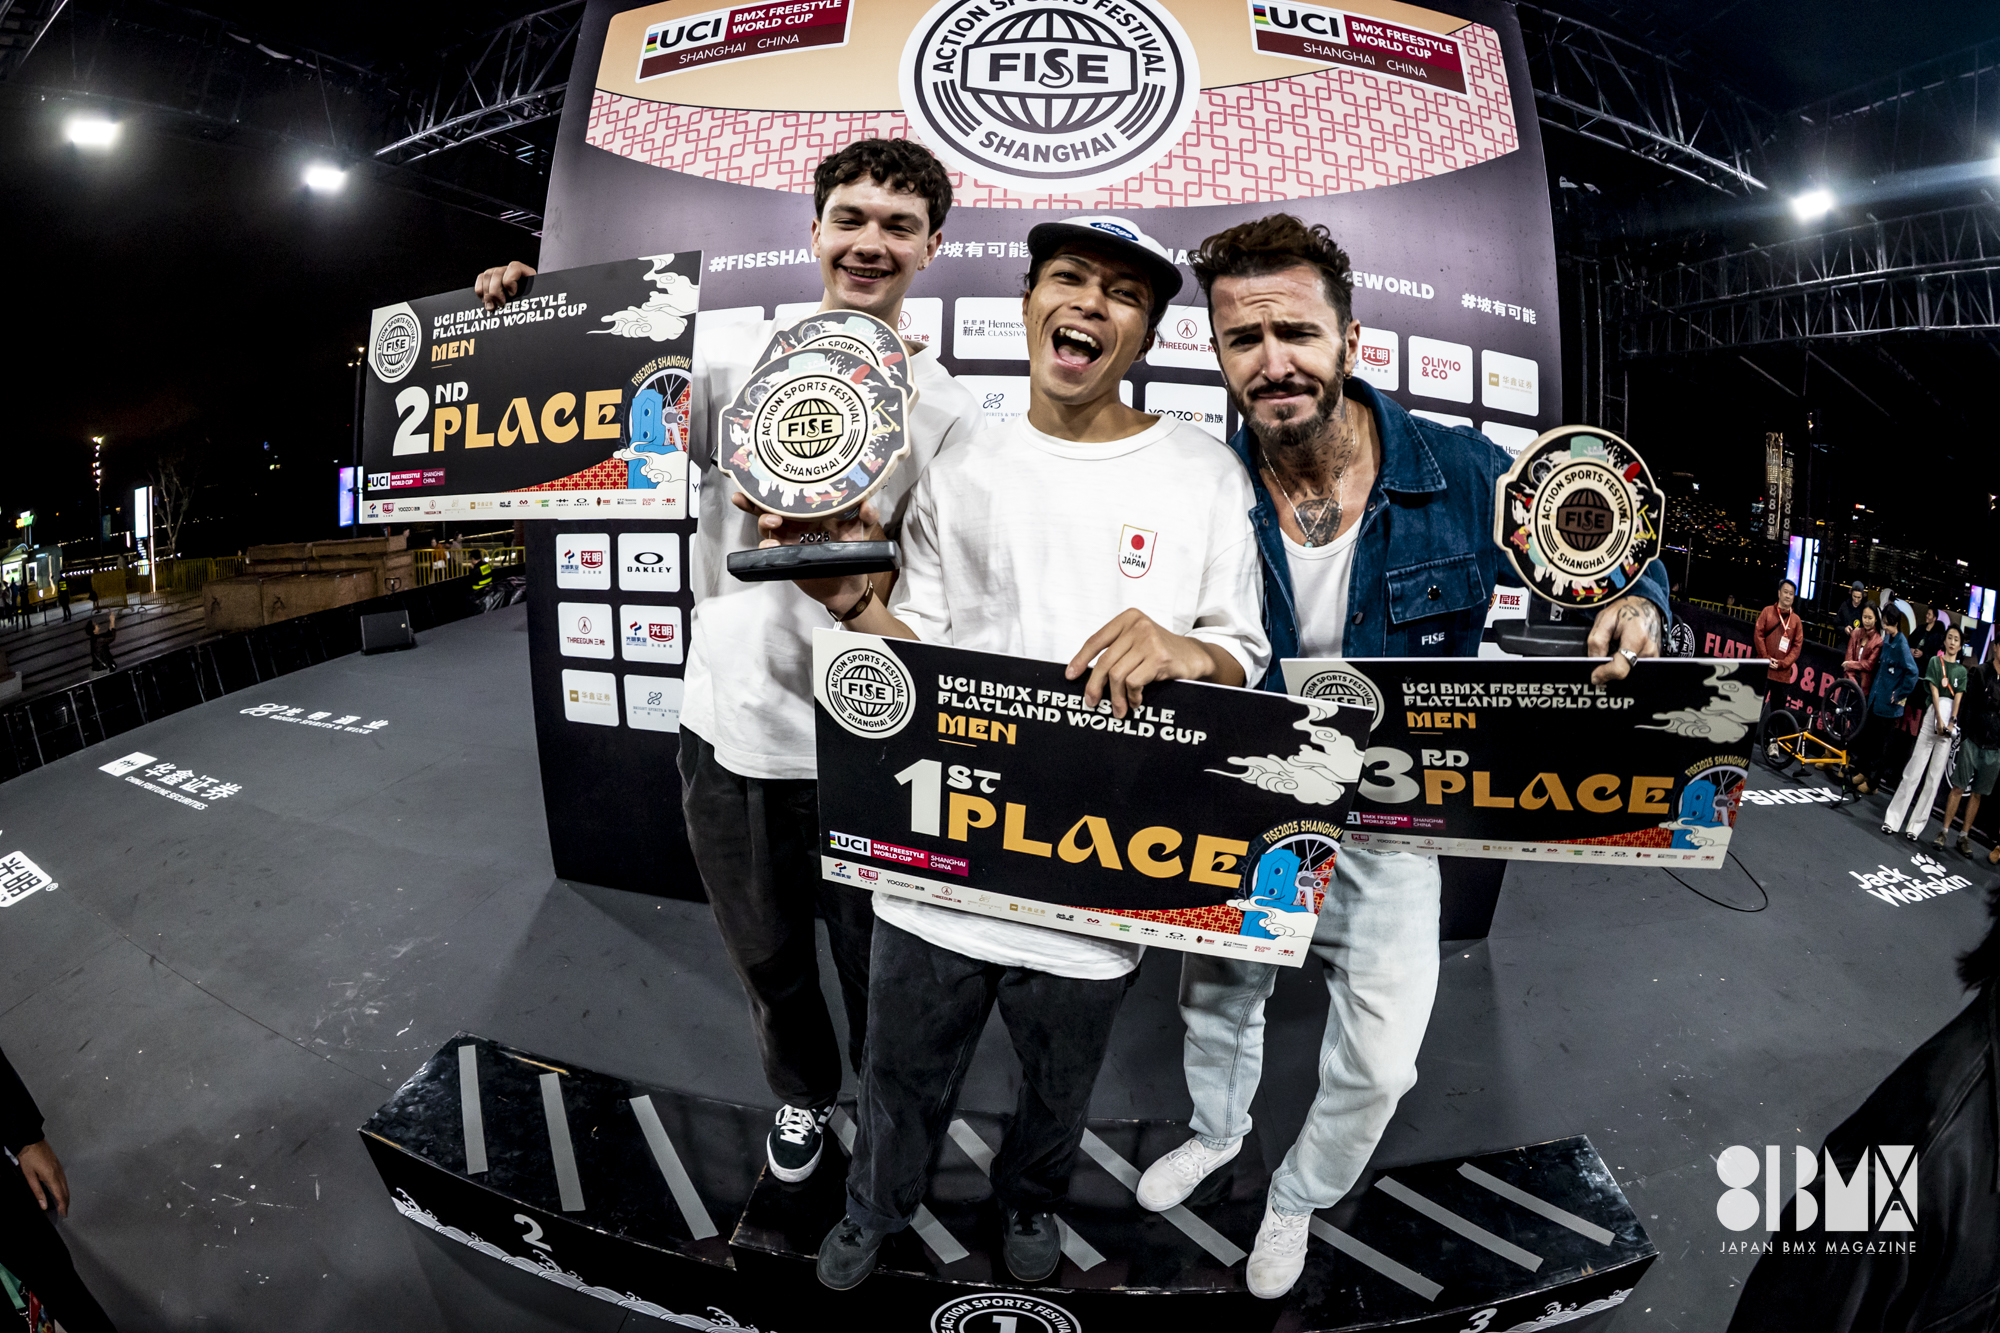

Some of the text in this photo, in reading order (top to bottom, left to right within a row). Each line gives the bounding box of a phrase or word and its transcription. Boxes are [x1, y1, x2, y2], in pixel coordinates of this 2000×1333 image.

[734, 0, 842, 23] BMX FREESTYLE
[1269, 7, 1340, 38] UCI
[659, 18, 722, 48] UCI
[732, 13, 813, 34] WORLD CUP
[679, 34, 800, 64] SHANGHAI CHINA
[932, 0, 1167, 76] ACTION FESTIVAL
[1352, 21, 1453, 55] BMX FREESTYLE
[1353, 33, 1432, 59] WORLD CUP
[988, 48, 1109, 88] FISE
[1303, 42, 1427, 79] SHANGHAI CHINA
[979, 131, 1117, 163] SHANGHAI
[1352, 271, 1435, 300] EWORLD
[434, 313, 455, 327] UCI
[457, 307, 484, 322] BMX
[1461, 293, 1537, 325] #坡有可能
[432, 303, 588, 340] FLATLAND WORLD CUP
[988, 320, 1026, 331] Henness
[378, 329, 388, 350] ACTION
[388, 318, 405, 328] SPORTS
[386, 339, 406, 352] FISE
[430, 338, 475, 362] MEN
[1158, 341, 1198, 351] THREEGUN
[1363, 347, 1389, 361] 光明
[384, 363, 405, 373] SHANGHAI
[631, 354, 692, 387] FISE2025 SHANGHAI
[1421, 355, 1461, 372] OLIVIO
[1421, 367, 1448, 380] & CO
[762, 381, 860, 436] ACTION SPORTS FESTIVAL
[1205, 413, 1223, 424] 游族
[433, 388, 622, 453] PLACE
[788, 419, 833, 438] FISE
[783, 458, 840, 477] SHANGHAI
[372, 475, 388, 487] UCI
[1542, 470, 1627, 526] ACTION SPORTS FESTIVAL
[1566, 511, 1605, 531] FISE
[800, 532, 830, 544] 2025
[582, 552, 602, 563] 光明
[1122, 556, 1146, 569] JAPAN
[1557, 553, 1606, 570] SHANGHAI
[567, 637, 593, 645] THREEGUN
[650, 625, 673, 637] 光明
[1421, 632, 1445, 645] FISE
[831, 654, 904, 698] ACTION SPORTS FESTIVAL
[848, 682, 886, 700] FISE
[938, 674, 1176, 724] UCI BMX FRESYLE
[1317, 675, 1347, 685] SPORTS
[1349, 678, 1374, 705] FESTIVAL
[1402, 683, 1607, 696] UCI BMX FREESTYLE
[1404, 695, 1635, 709] FLATLAND WORLD CUP
[847, 712, 888, 727] SHANGHAI
[937, 691, 1207, 746] FLATLAND WORLD CUP
[937, 712, 1018, 746] MEN
[1406, 711, 1477, 729] MEN
[1685, 754, 1749, 778] FISE2025 SHANGHAI
[124, 775, 208, 810] CHINA FORTUNE SECURITIES
[145, 762, 243, 800] 华鑫证券
[1423, 770, 1675, 814] PLACE
[1739, 787, 1849, 806] SHOCK
[948, 792, 1249, 889] PLACE
[1263, 819, 1344, 844] FISE2025 SHANGHAI
[836, 835, 868, 853] UCI
[873, 843, 925, 860] BMX FREESTYLE
[873, 849, 913, 863] WORLD CUP
[930, 855, 966, 868] SHANGHAI
[930, 861, 952, 871] CHINA
[886, 879, 914, 889] YOOZOO
[1849, 865, 1912, 890] Jack
[1866, 875, 1973, 907] Wolfskin
[513, 1213, 552, 1252] 2
[941, 1299, 1072, 1333] ACTION SPORTS FESTIVA
[1460, 1307, 1498, 1333] 3
